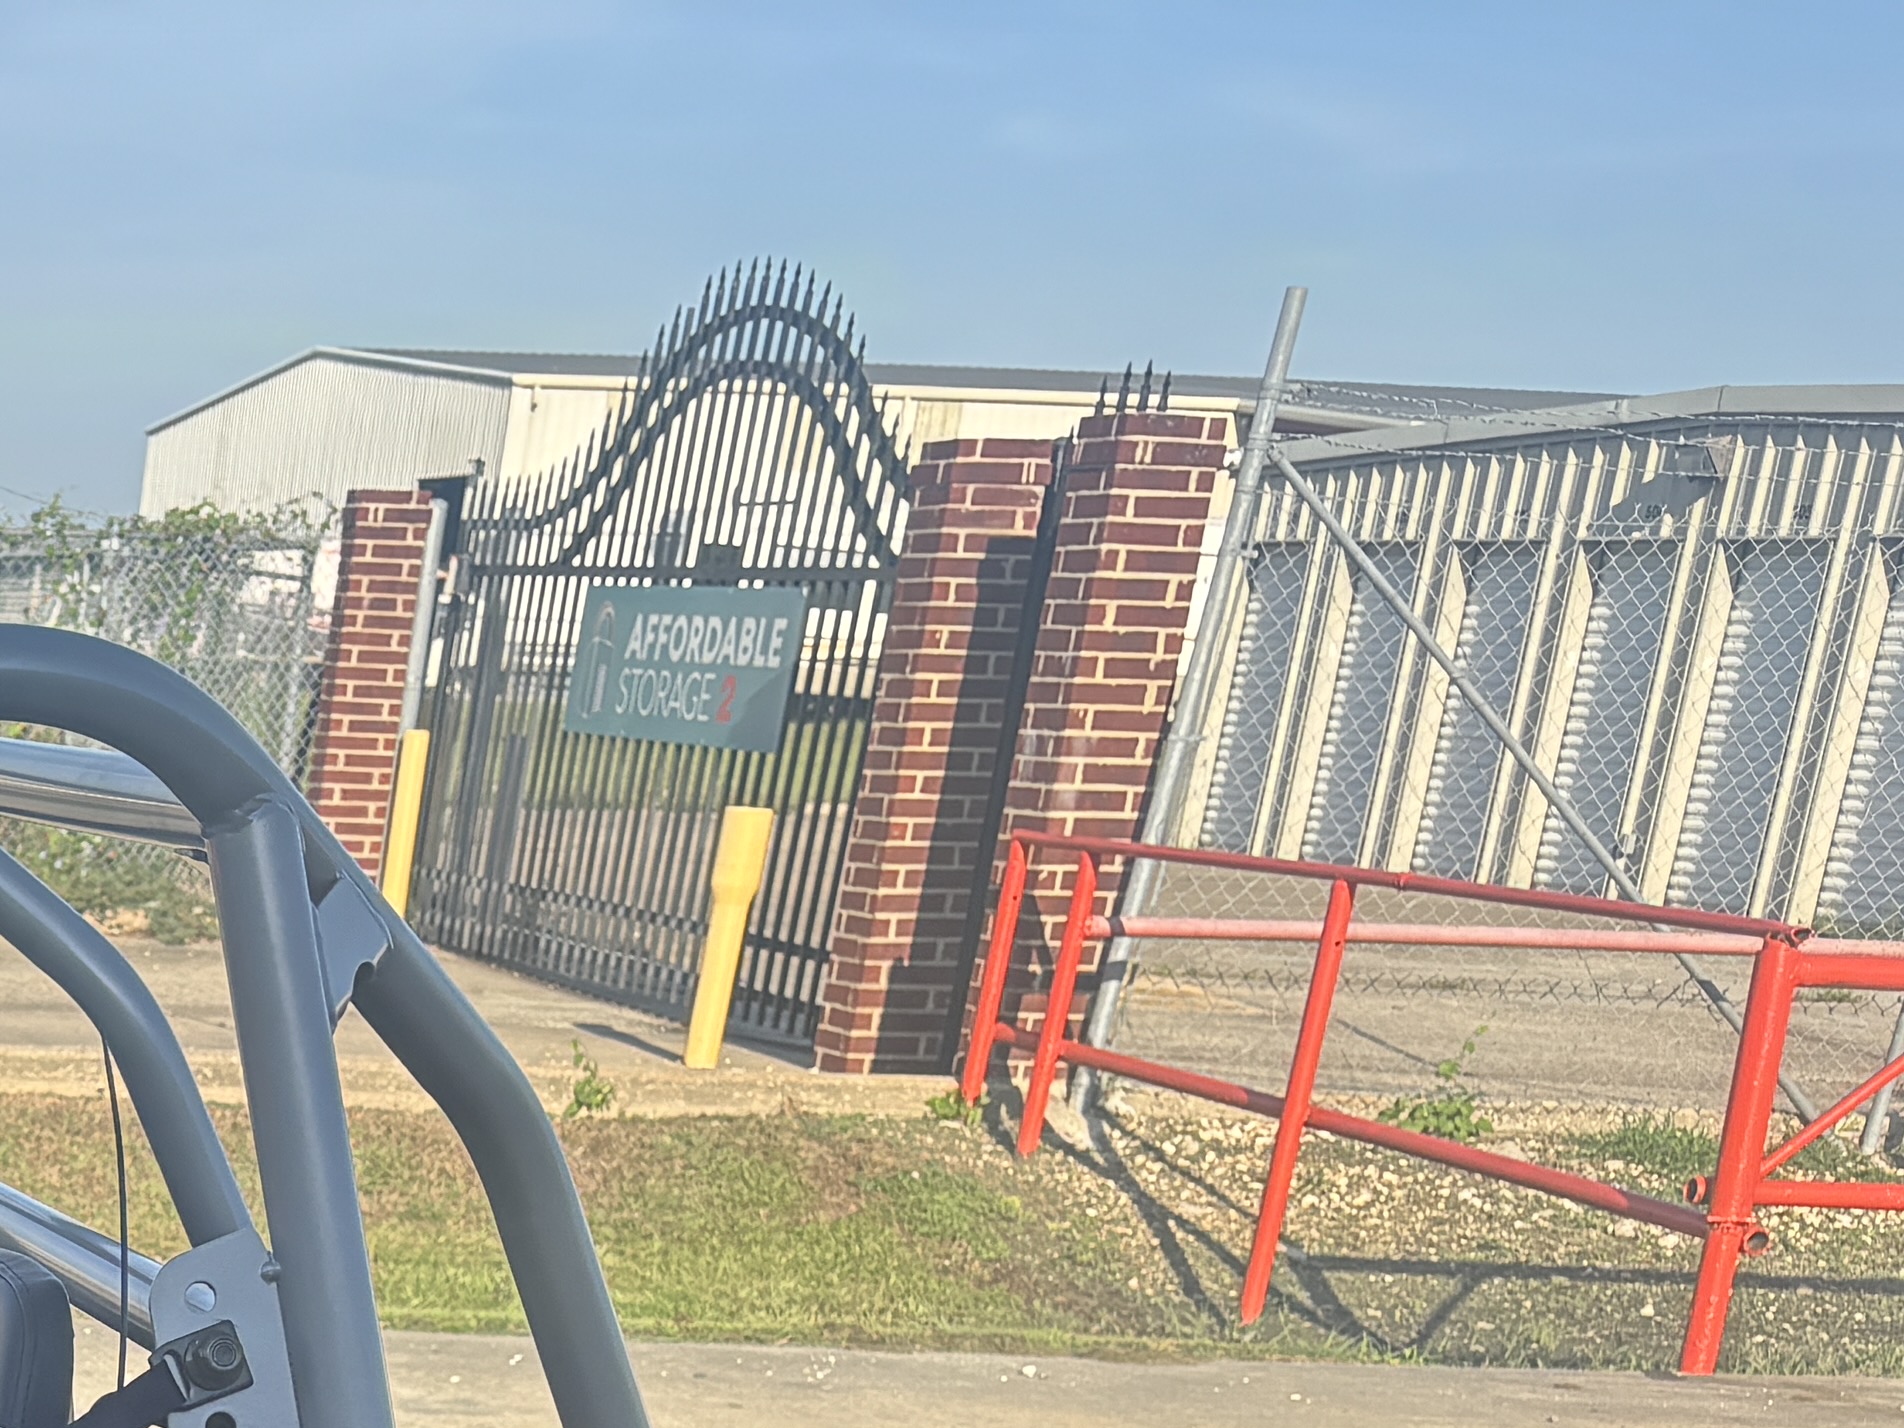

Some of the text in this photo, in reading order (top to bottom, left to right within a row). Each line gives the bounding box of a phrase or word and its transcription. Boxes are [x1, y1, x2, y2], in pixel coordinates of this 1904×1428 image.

[624, 612, 789, 668] AFFORDABLE
[614, 667, 737, 724] STORAGE 2
